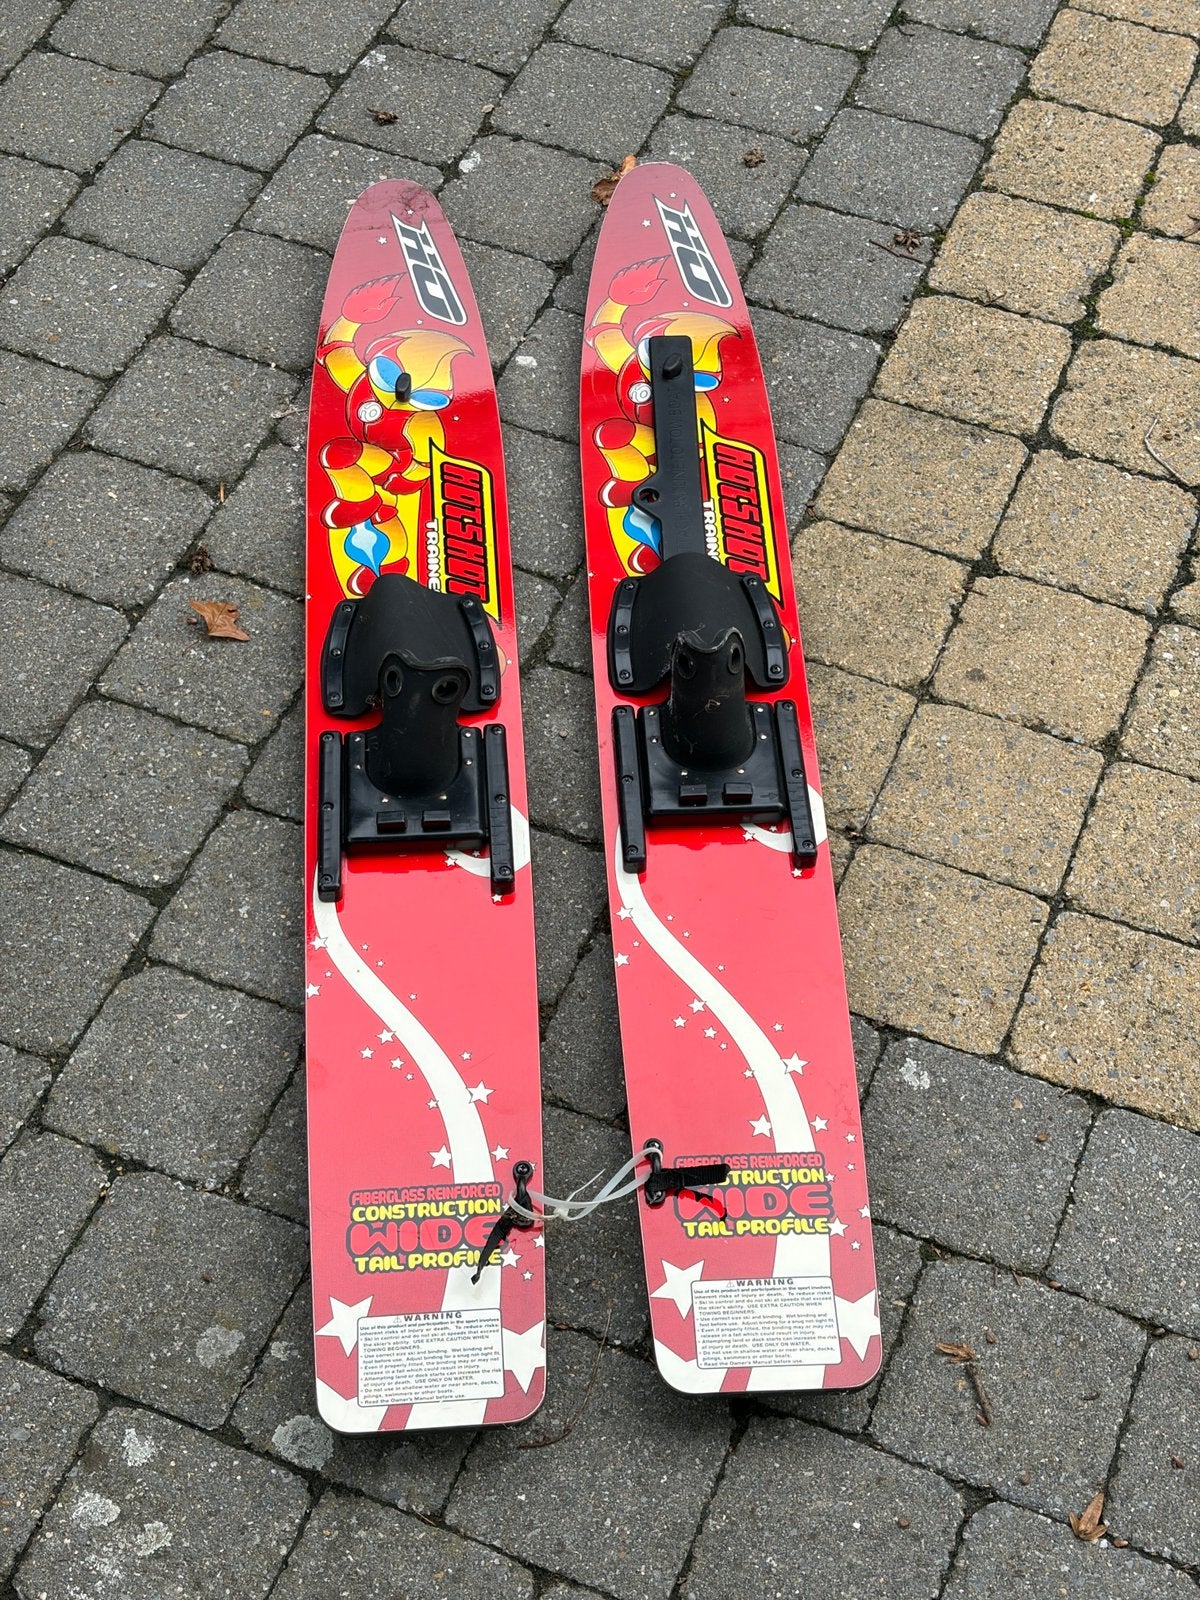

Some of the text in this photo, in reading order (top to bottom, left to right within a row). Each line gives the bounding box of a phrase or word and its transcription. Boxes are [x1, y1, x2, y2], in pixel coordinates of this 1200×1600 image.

[653, 194, 732, 308] HO
[390, 210, 467, 326] HO
[703, 498, 720, 562] TRAIN
[425, 519, 441, 592] TRAINE
[751, 1153, 823, 1168] REINFORCED
[717, 1168, 825, 1186] TRUCTION
[351, 1183, 501, 1205] FIBERGLASS REINFORCED
[677, 1184, 831, 1220] WIDE
[352, 1198, 501, 1222] CONSTRUCTION
[350, 1215, 506, 1255] WIDE
[683, 1217, 830, 1237] TAIL PROFILE
[354, 1256, 405, 1273] TAIL
[736, 1278, 794, 1287] WARNING
[404, 1311, 462, 1322] WARNING
